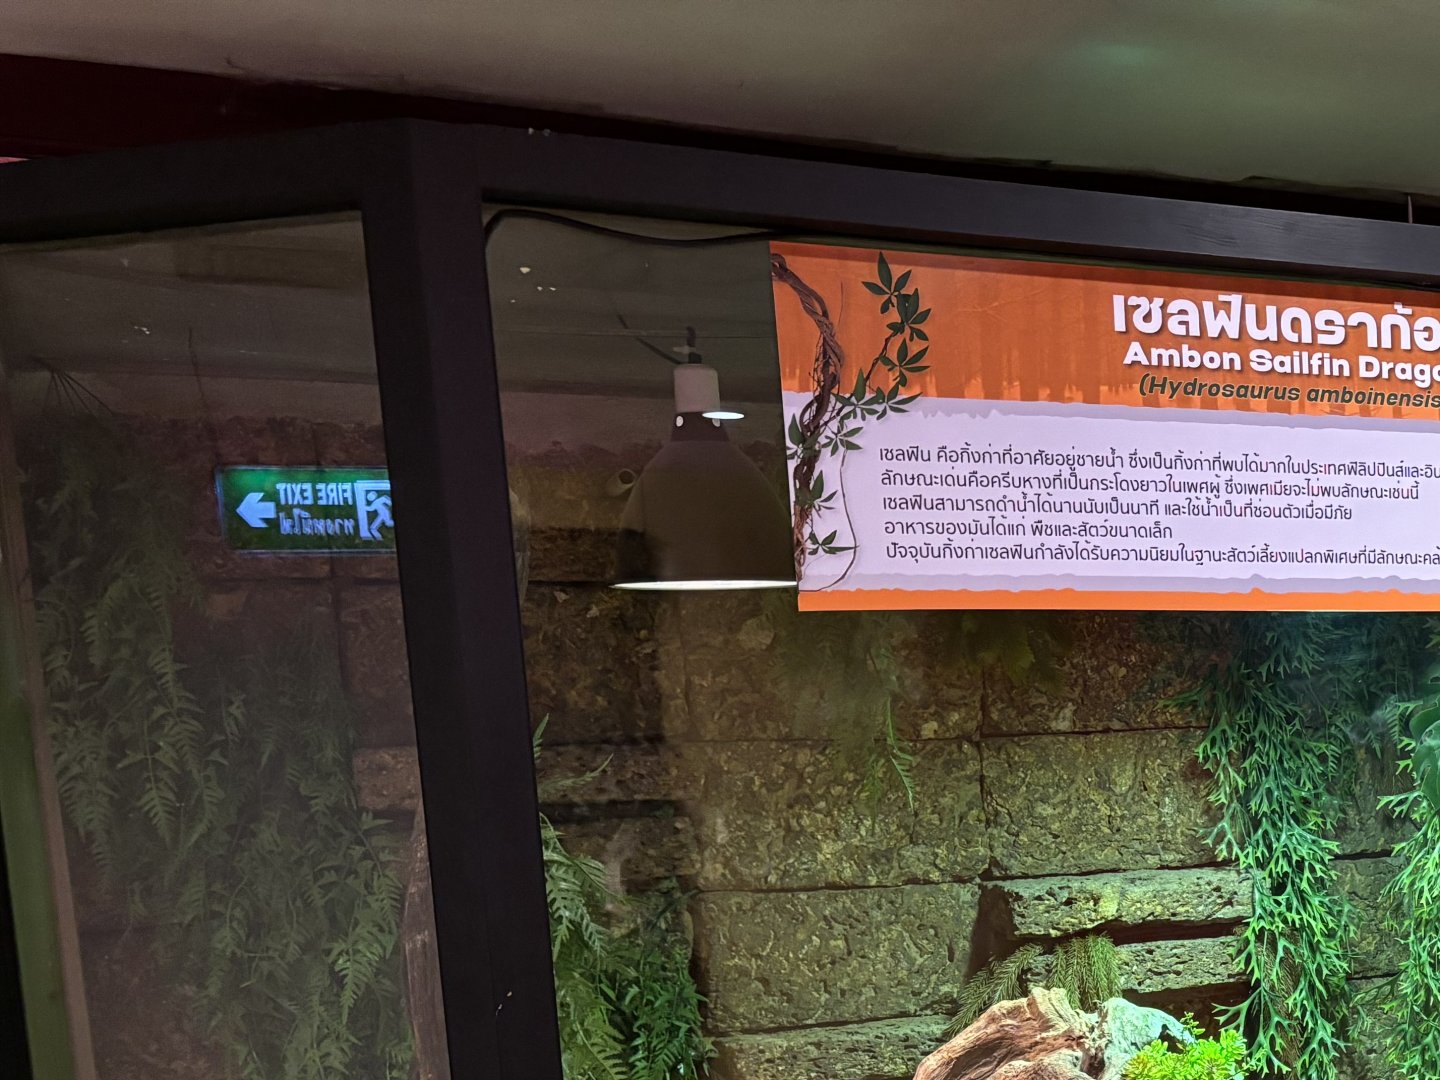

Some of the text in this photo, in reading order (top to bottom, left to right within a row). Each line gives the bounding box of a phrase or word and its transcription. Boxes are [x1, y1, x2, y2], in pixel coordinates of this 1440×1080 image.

[1123, 341, 1241, 371] Ambon
[1249, 348, 1351, 378] Sailfin
[1138, 373, 1301, 402] (Hydrosaurus
[879, 445, 931, 463] เซลฟิน
[936, 441, 1124, 472] คือกิ้งก่าที่อาศัยอยู่ชายน้ำ
[1224, 474, 1420, 500] ซึ่งเพศเมียจะไม่พบลักษณะเช่นนี้
[882, 491, 1353, 520] เซลฟินสามารถดำน้ำได้นานนับเป็นนาที และใช้น้ำเป็นที่ซ่อนตัวเมื่อมีภัย
[884, 515, 1173, 539] อาหารของมันได้แก่ พืชและสัตว์ขนาดเล็ก
